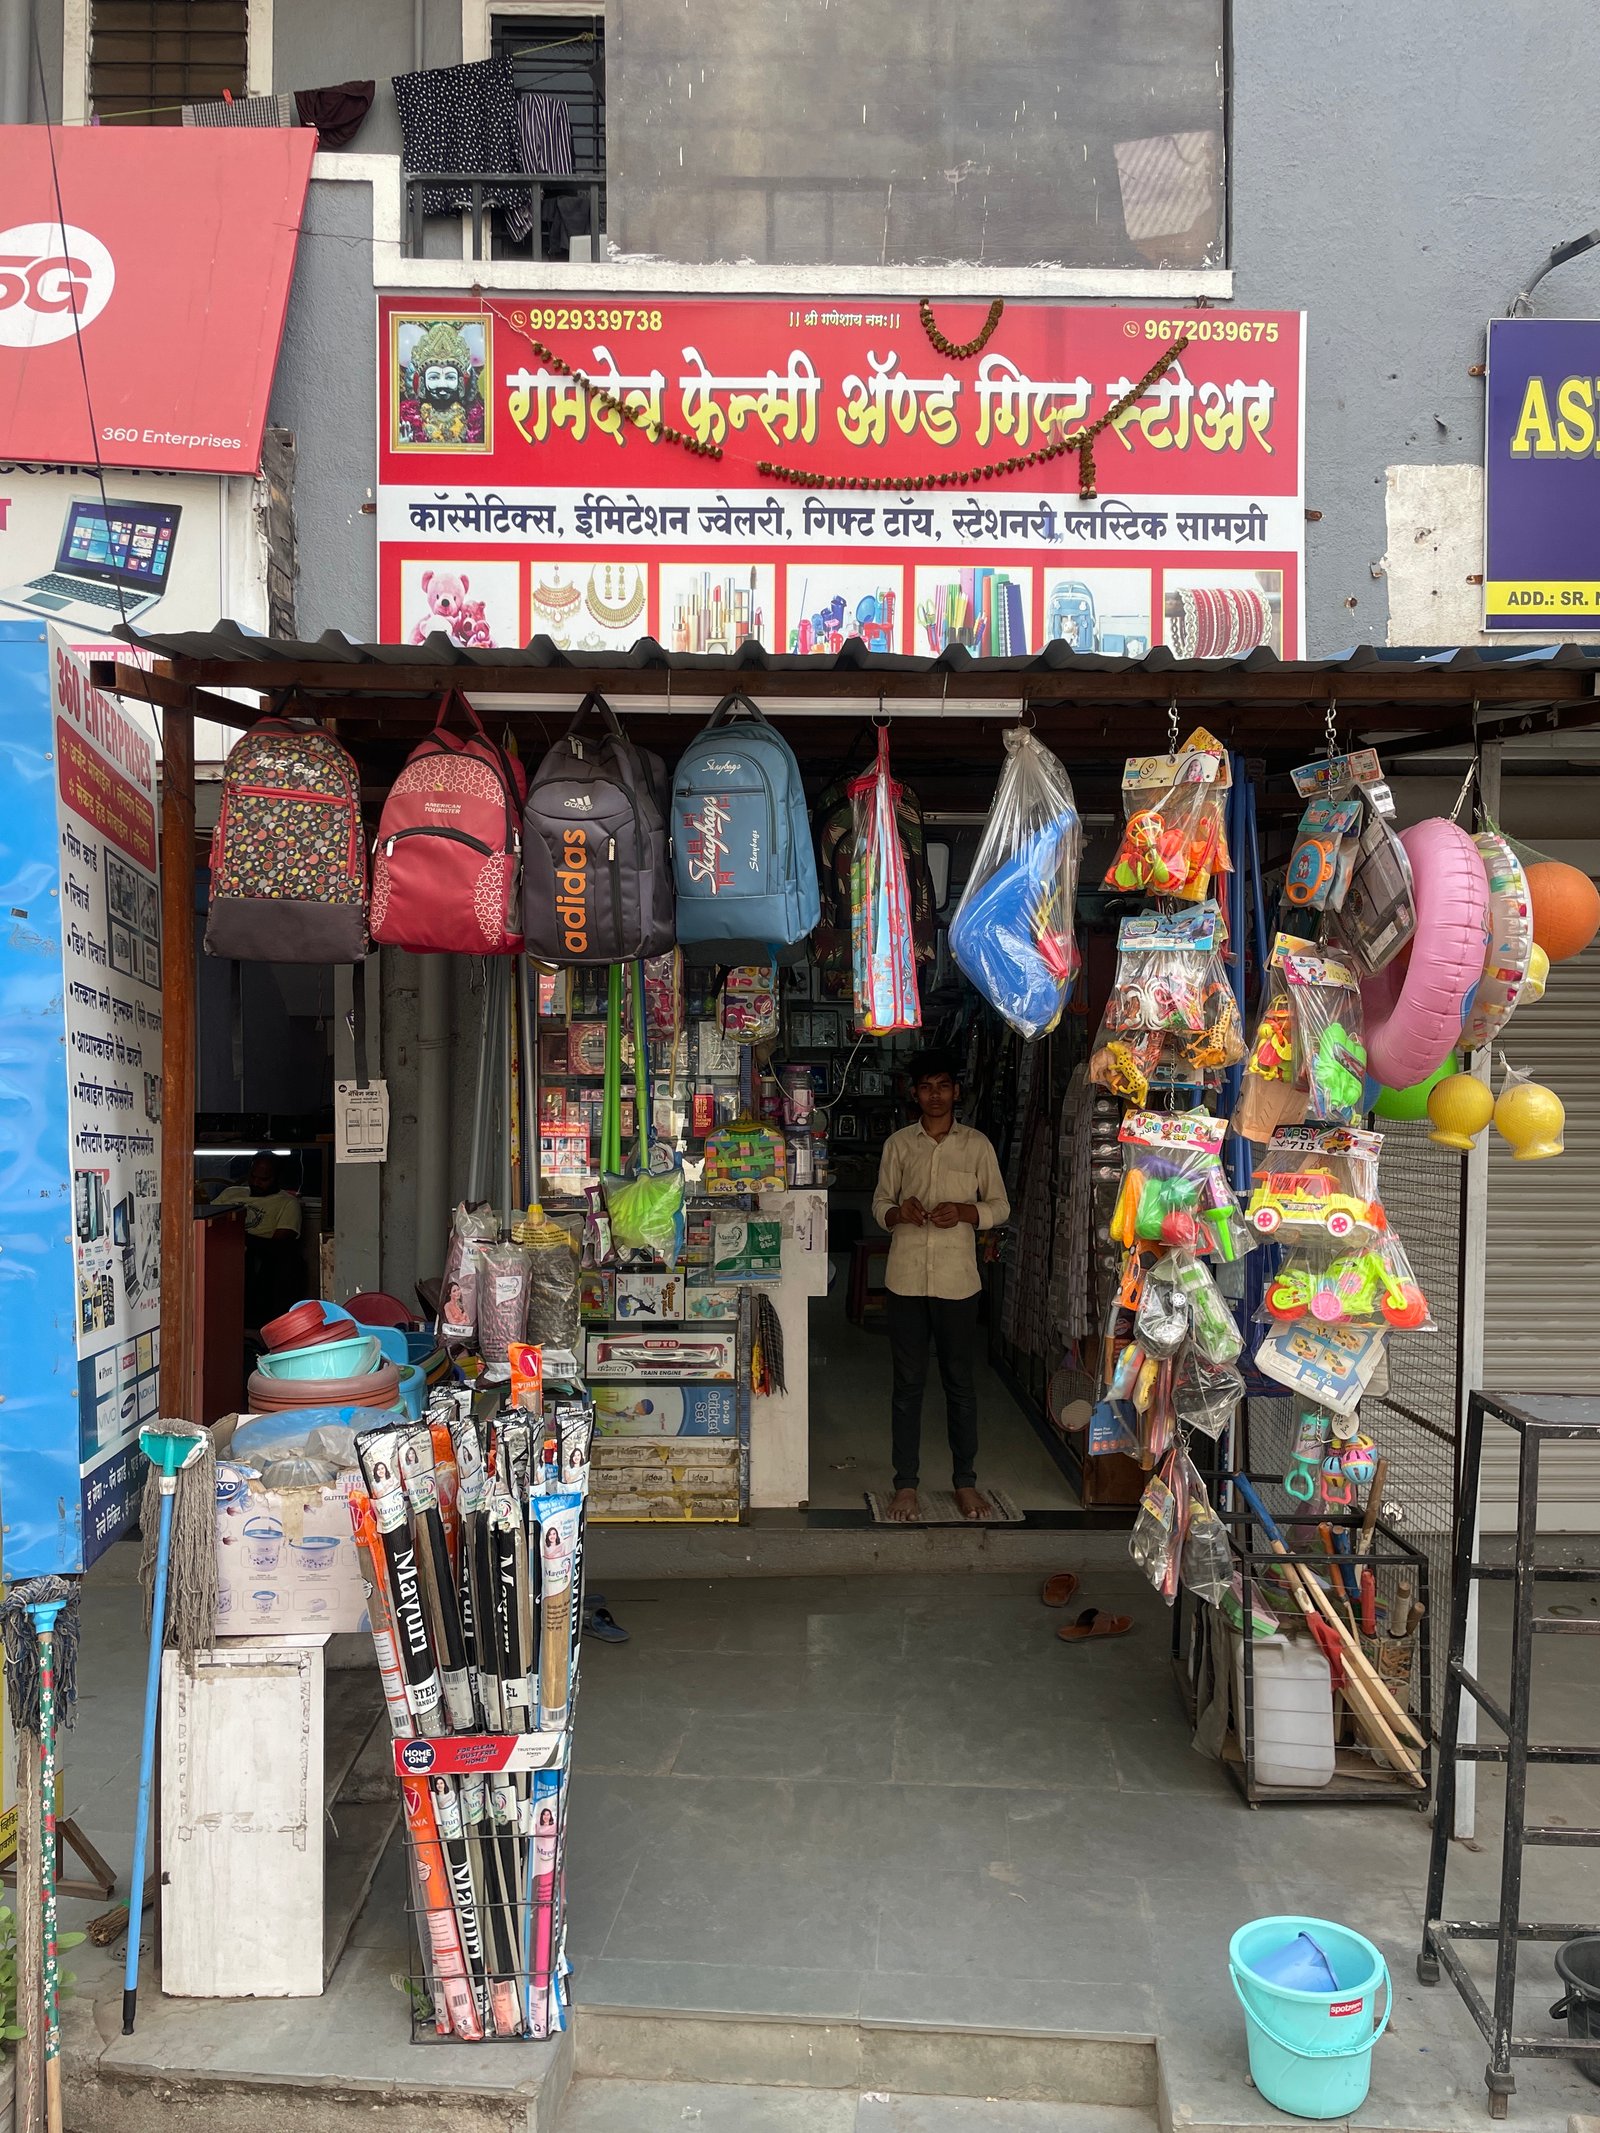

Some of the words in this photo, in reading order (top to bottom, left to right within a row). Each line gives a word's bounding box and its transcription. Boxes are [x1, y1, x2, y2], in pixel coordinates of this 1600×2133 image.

[529, 309, 663, 332] 9929339738
[804, 309, 818, 326] श्री
[821, 309, 862, 327] गणेशाय
[1144, 319, 1279, 343] 9672039675
[507, 345, 666, 447] रामदेव
[679, 346, 822, 446] फेन्सी
[1511, 377, 1600, 454] AS
[101, 427, 138, 443] 360
[142, 430, 242, 449] Enterprises
[409, 493, 565, 539] कॉस्मेटिक्स,
[574, 493, 690, 539] ईमिटेशन
[698, 495, 793, 540] ज्वेलरी,
[803, 496, 876, 540] गिफ्ट
[883, 496, 941, 542] टॉय,
[1176, 502, 1269, 544] सामग्री
[1506, 591, 1555, 607] ADD.:
[1560, 590, 1589, 607] SR.
[57, 646, 81, 723] 360
[83, 674, 151, 793] ENTERPRISES
[292, 761, 321, 778] Bags
[424, 802, 461, 810] AMERICAN
[564, 798, 594, 812] adidas
[66, 823, 81, 861] सिम
[83, 843, 97, 873] कार्ड
[687, 795, 733, 896] Skaybags
[749, 829, 759, 873] Skaybags
[69, 872, 90, 913] रिचार्ज
[556, 829, 588, 953] adidas
[88, 931, 107, 968] रिचार्ज
[74, 981, 97, 1010] तत्काल
[78, 1072, 103, 1109] मोबाईल
[1136, 1117, 1203, 1135] Vegetable
[1275, 1127, 1320, 1141] GYPSY
[695, 1402, 706, 1423] Set
[708, 1391, 720, 1433] Cricket
[459, 1546, 475, 1637] ayuri
[405, 1749, 432, 1758] HOME
[461, 1752, 479, 1760] DUST
[480, 1749, 498, 1757] FREE
[473, 1743, 495, 1751] CLEAN
[409, 1756, 429, 1764] ONE
[465, 1757, 488, 1765] HOME!
